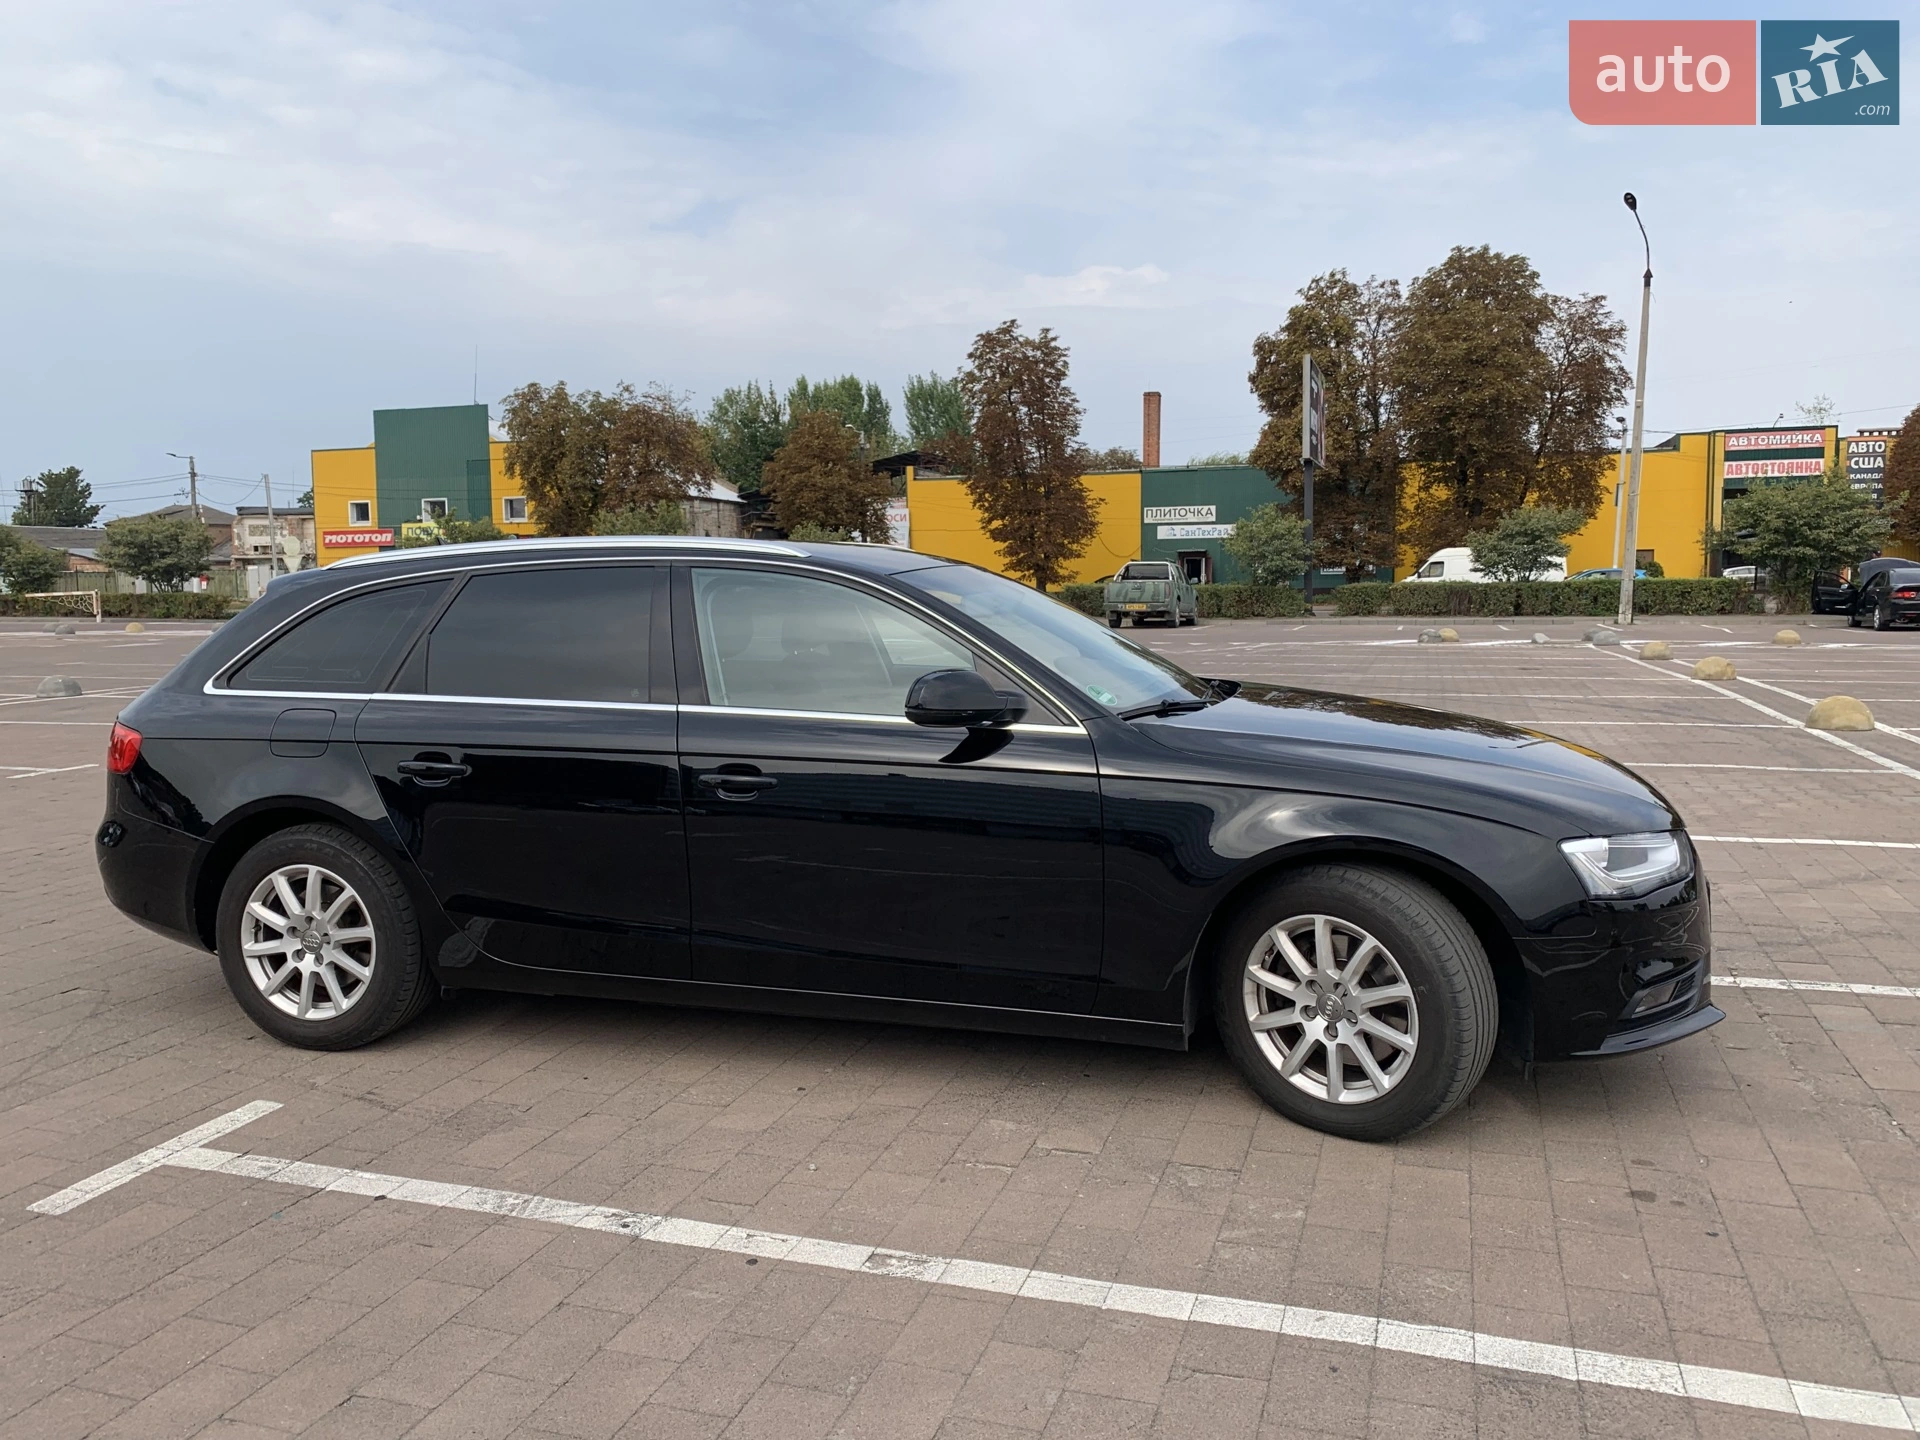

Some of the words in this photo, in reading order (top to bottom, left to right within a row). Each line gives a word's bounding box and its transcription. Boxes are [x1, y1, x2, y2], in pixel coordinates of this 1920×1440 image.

[1729, 432, 1822, 446] АВТОМИЙКА
[1848, 441, 1885, 453] АВТО
[1850, 456, 1884, 468] США
[1726, 461, 1822, 476] АВТОСТОЯНКА
[1145, 507, 1214, 518] ПЛИТОЧКА
[324, 533, 392, 544] МОТОТОП
